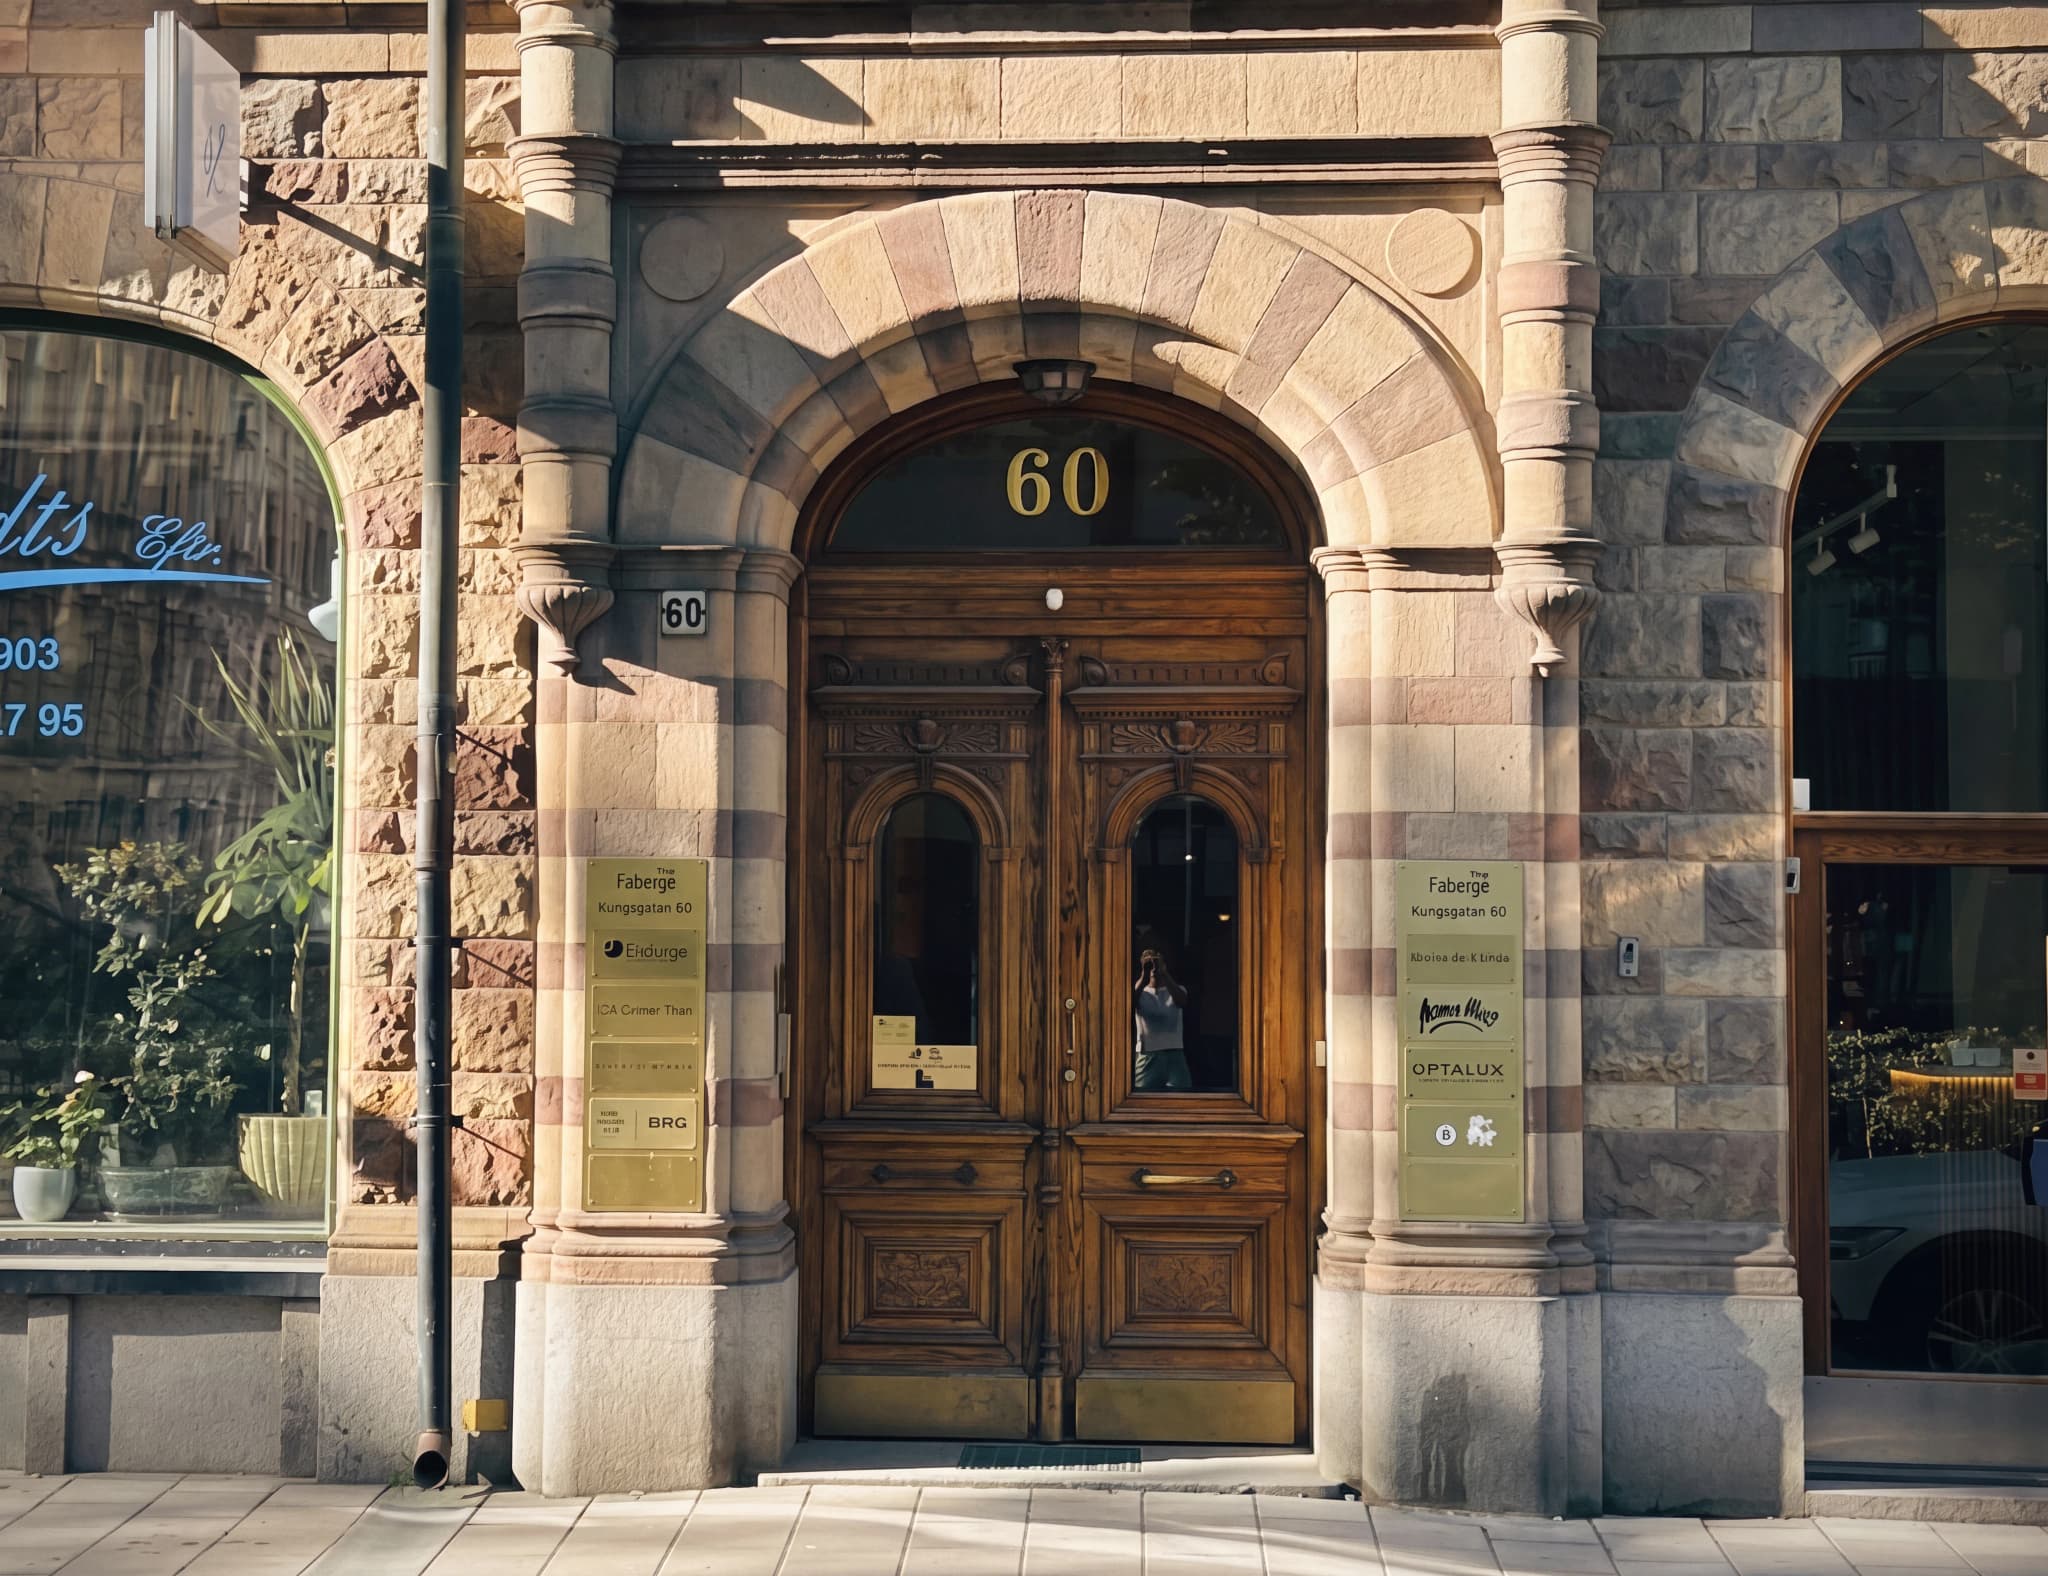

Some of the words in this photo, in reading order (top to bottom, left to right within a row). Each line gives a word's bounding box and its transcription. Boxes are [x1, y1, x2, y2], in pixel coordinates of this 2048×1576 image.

[1006, 447, 1110, 516] 60
[665, 597, 702, 628] 60
[0, 637, 60, 671] 903
[0, 703, 28, 737] 7
[38, 703, 84, 737] 95
[617, 873, 676, 894] Faberge
[1429, 876, 1489, 898] Faberge
[598, 902, 672, 916] Kungsgatan
[676, 902, 692, 914] 60
[1411, 905, 1486, 919] Kungsgatan
[1490, 905, 1507, 918] 60
[663, 1003, 693, 1016] Than
[1412, 1063, 1504, 1076] OPTALUX
[648, 1116, 687, 1129] BRG
